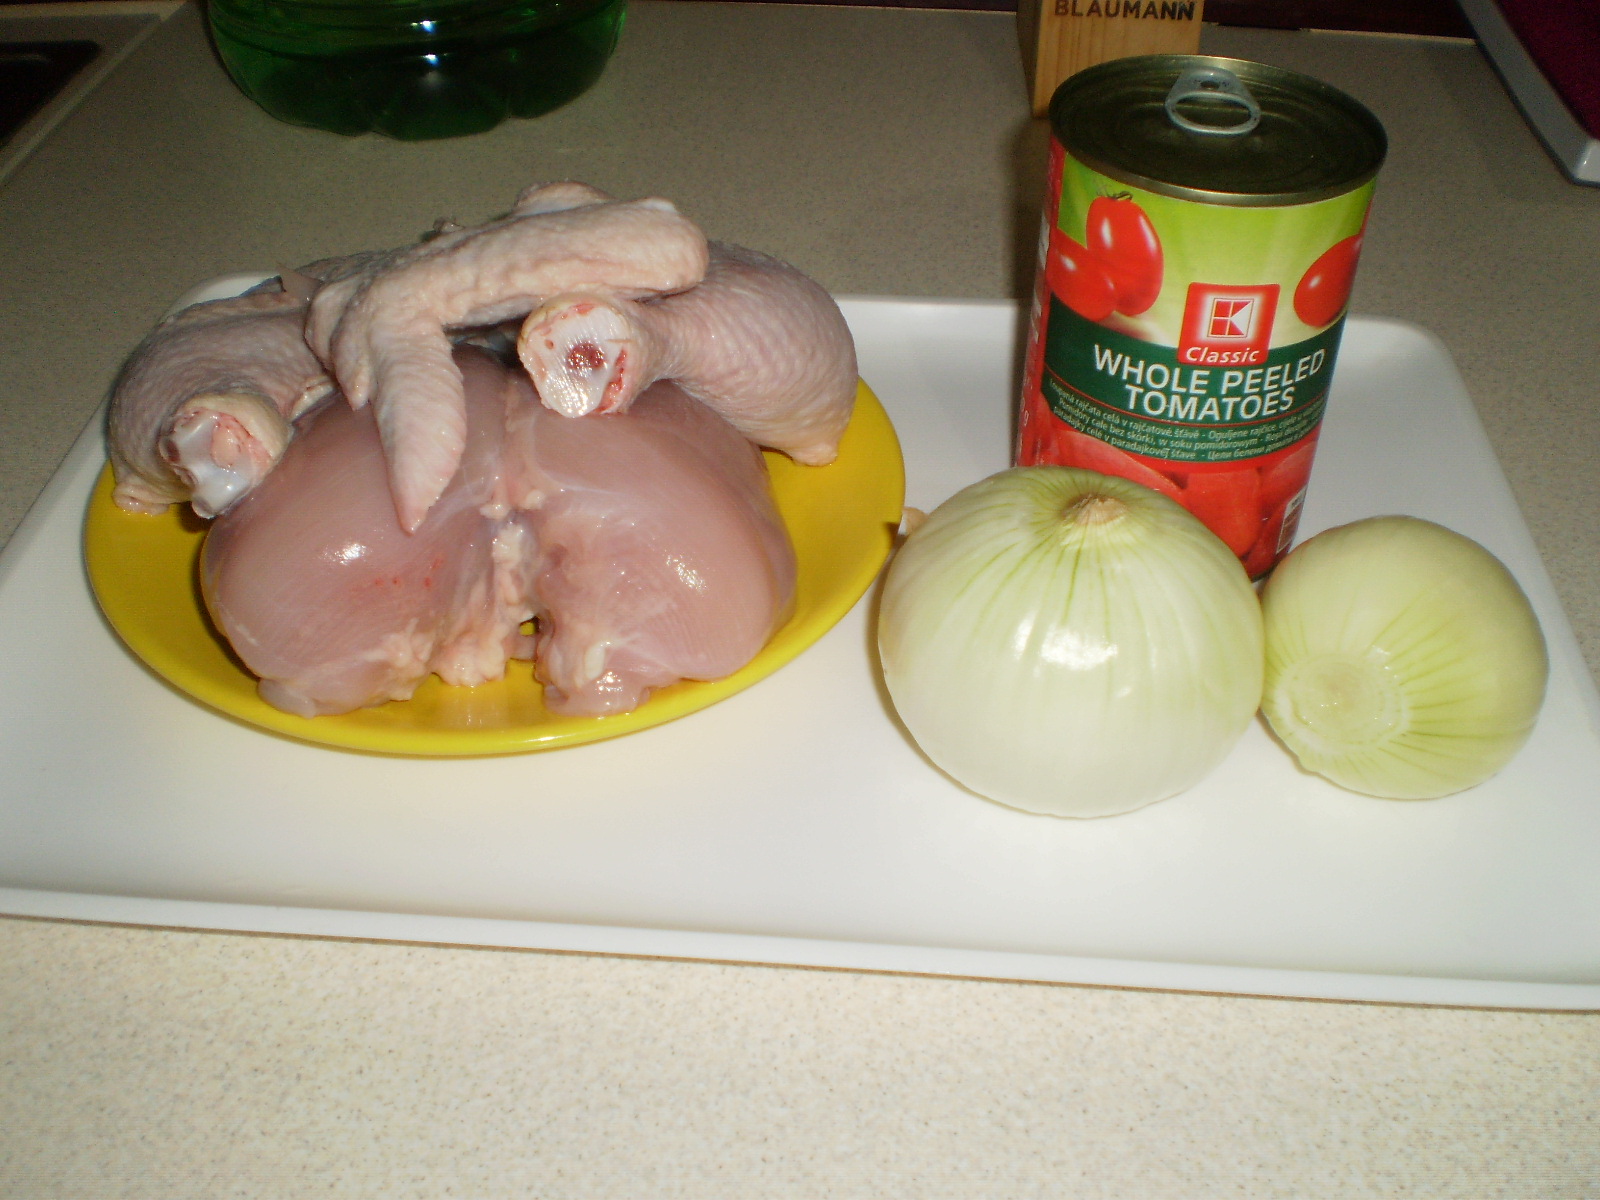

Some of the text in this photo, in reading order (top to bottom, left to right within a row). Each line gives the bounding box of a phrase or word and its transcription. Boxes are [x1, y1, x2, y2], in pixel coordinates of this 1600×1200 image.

[1055, 0, 1195, 21] BLAUMANN
[1186, 346, 1260, 363] Classic
[1094, 344, 1325, 395] WHOLE PEELED
[1125, 384, 1295, 421] TOMATOES
[1122, 419, 1128, 427] v
[1104, 434, 1110, 442] v
[1109, 423, 1125, 437] bez
[1169, 438, 1192, 449] soku
